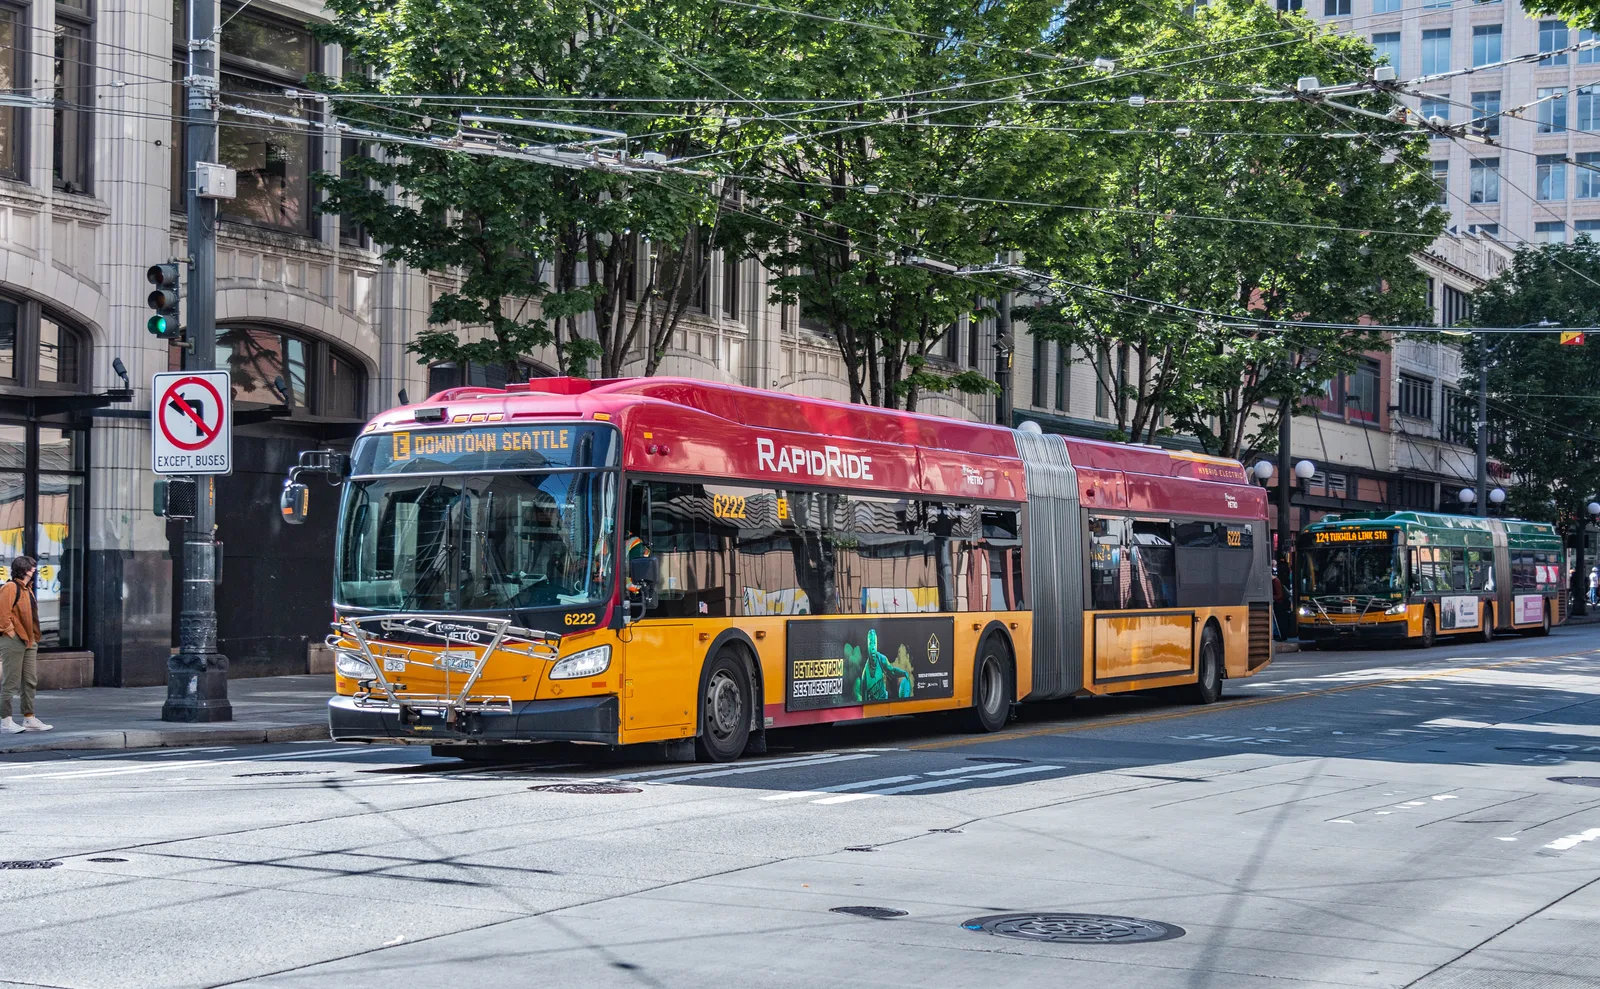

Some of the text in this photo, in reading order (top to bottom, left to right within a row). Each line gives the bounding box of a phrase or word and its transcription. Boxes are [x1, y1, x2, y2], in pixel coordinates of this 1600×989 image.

[415, 433, 497, 454] DOWNTOWN
[502, 429, 569, 451] SEATTLE
[157, 454, 226, 467] EXCEPT BUSES
[967, 475, 984, 486] METRO
[1197, 466, 1244, 480] HYBRID ELECTRIC
[713, 493, 746, 519] 6222
[1227, 530, 1241, 547] 6222
[1315, 530, 1388, 543] 124 TUKWILA LINK STA
[564, 612, 596, 626] 6222
[793, 659, 844, 679] BE THE STORM
[793, 678, 843, 697] SEE THE STORM
